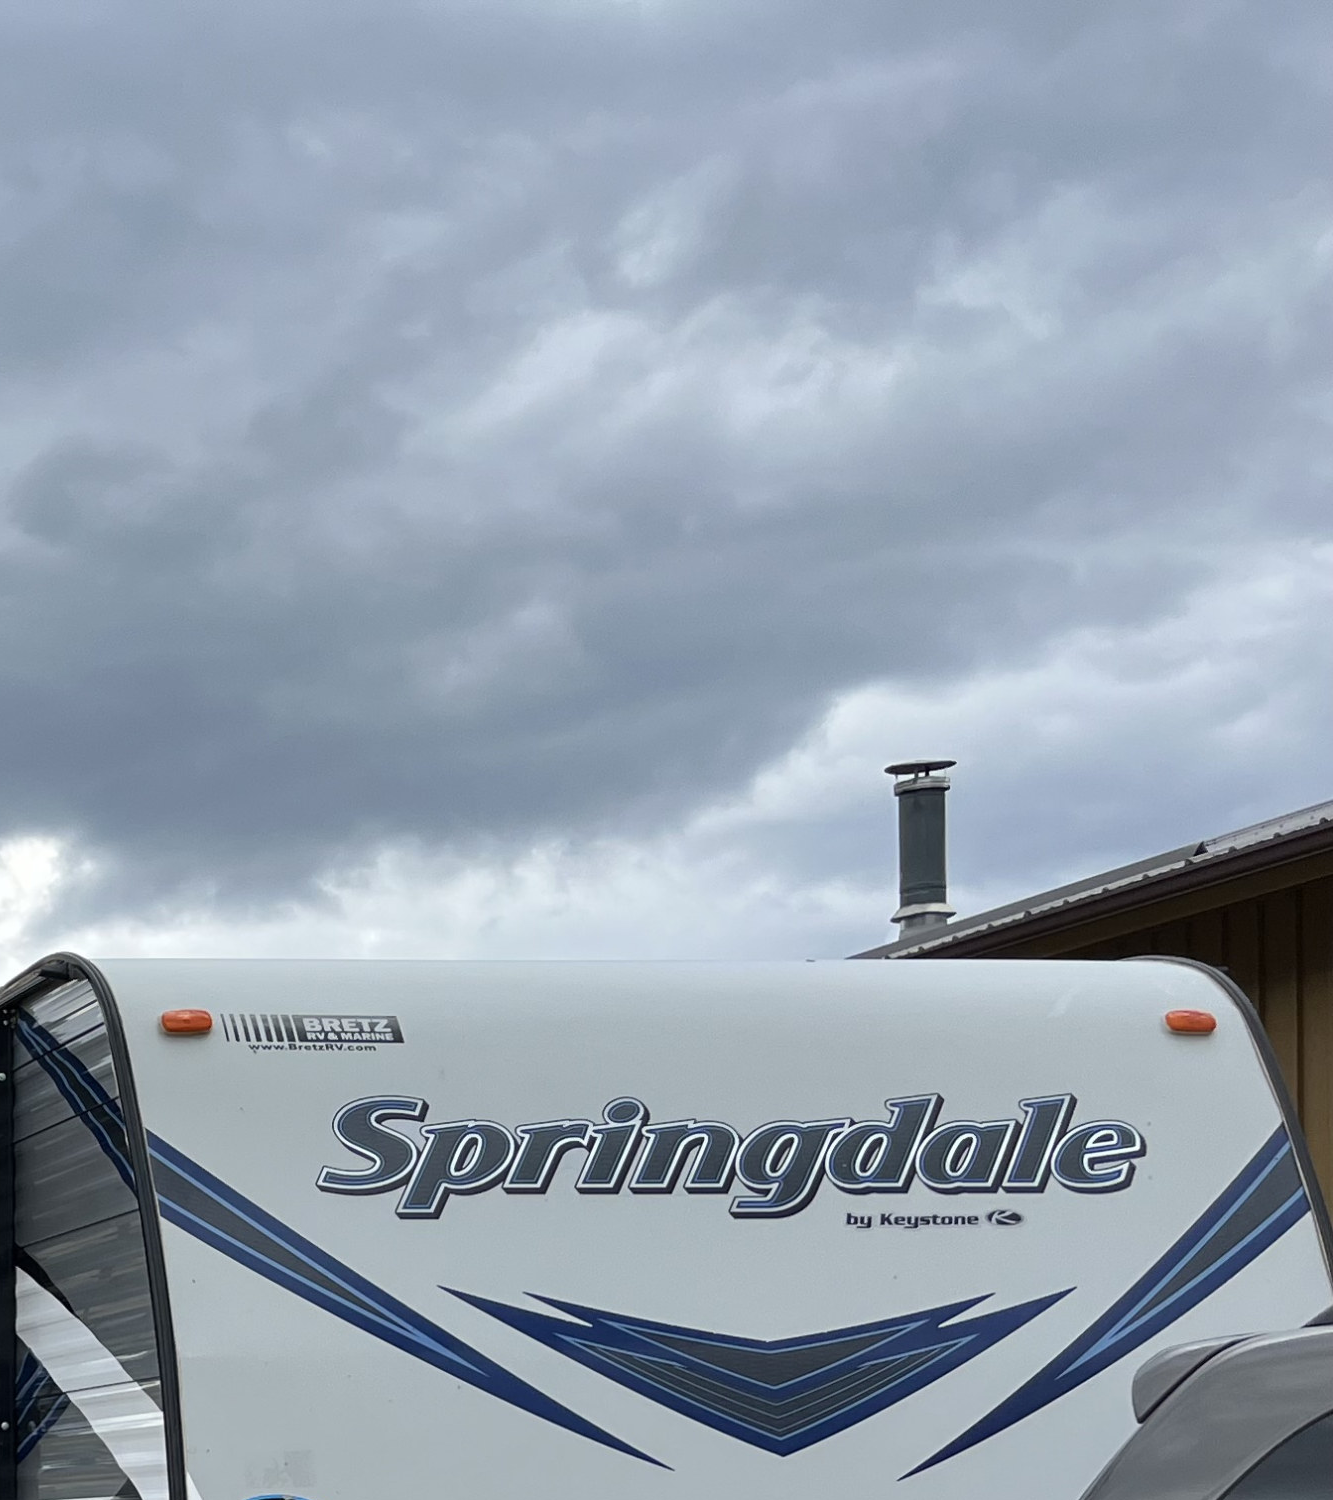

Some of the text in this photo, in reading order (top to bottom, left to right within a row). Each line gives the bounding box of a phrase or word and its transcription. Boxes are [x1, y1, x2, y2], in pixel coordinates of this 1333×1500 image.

[302, 1017, 392, 1032] BRETZ
[307, 1032, 394, 1041] RV & MARINE
[248, 1043, 377, 1051] www.BretzRV.com
[316, 1093, 1145, 1219] Springdale
[846, 1212, 979, 1229] by Keystone
